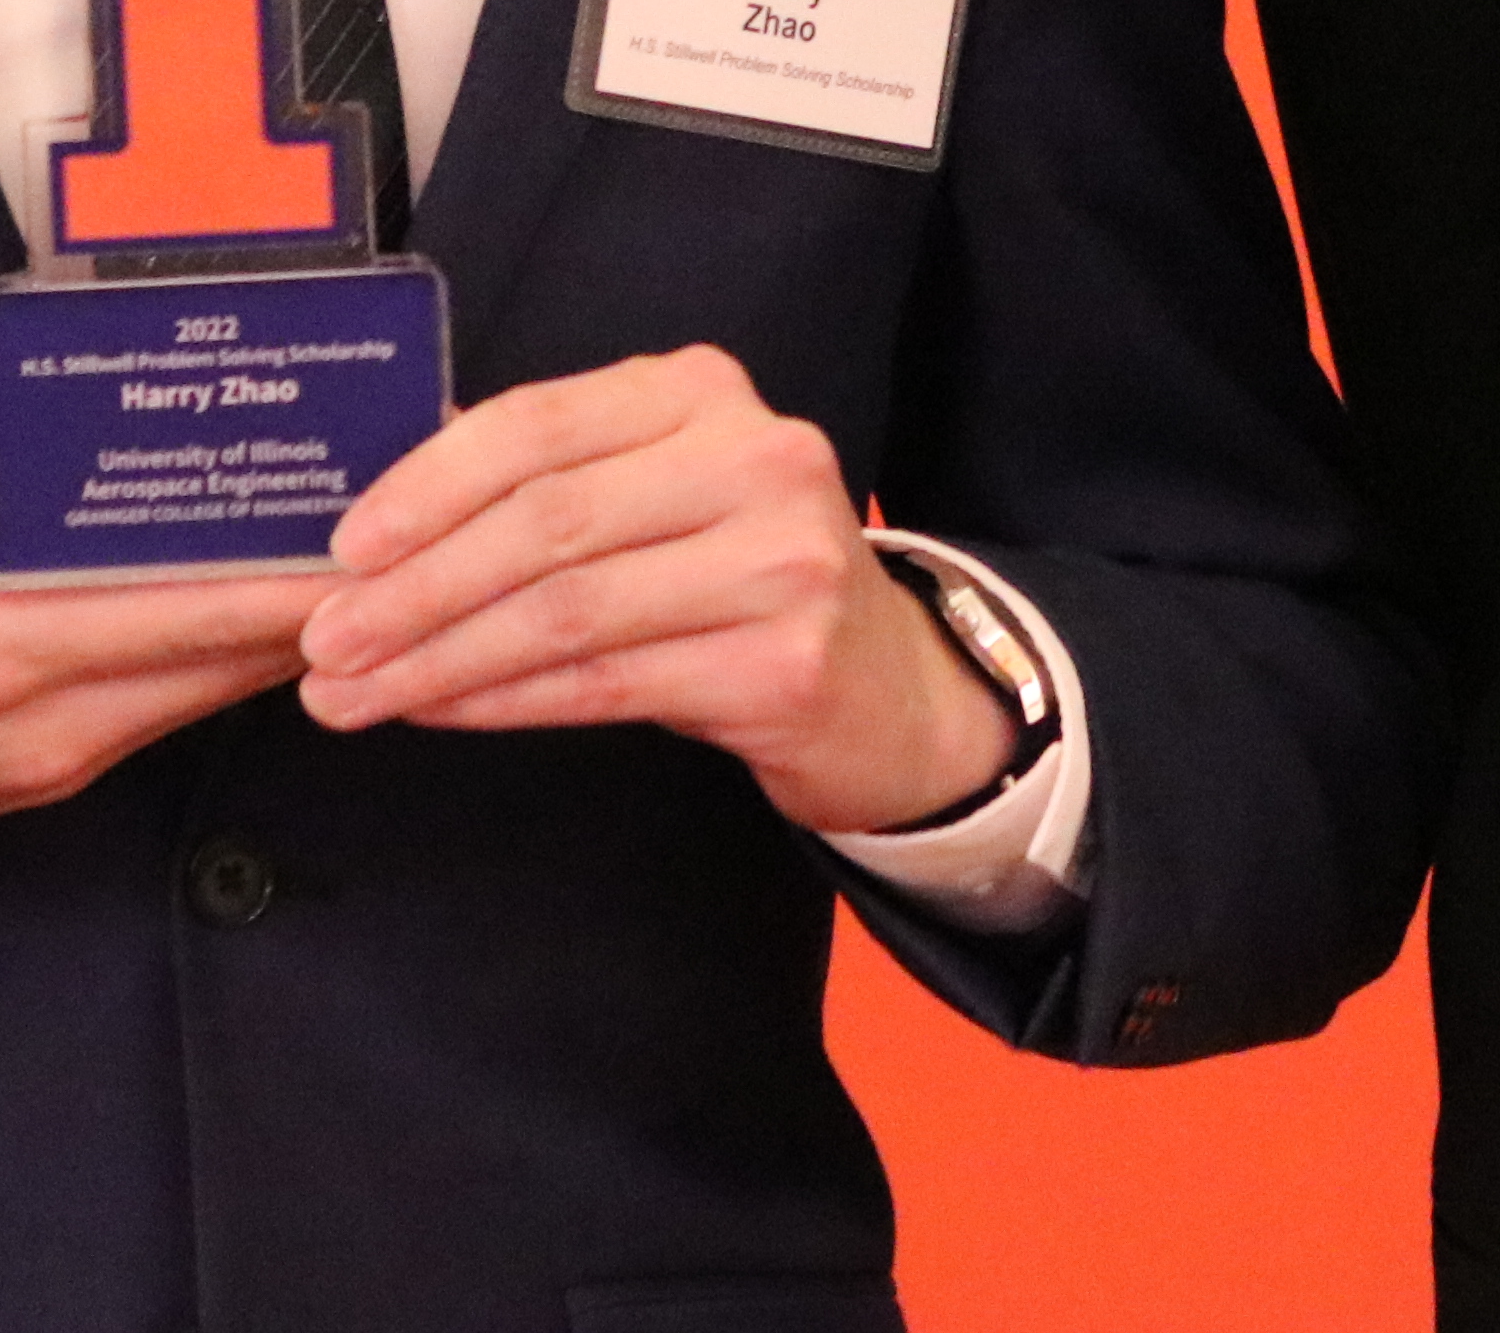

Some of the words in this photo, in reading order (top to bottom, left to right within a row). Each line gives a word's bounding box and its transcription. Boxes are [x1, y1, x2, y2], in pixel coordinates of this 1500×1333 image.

[742, 3, 817, 42] Zhao
[719, 49, 778, 75] Problem
[782, 61, 832, 89] Solving
[836, 71, 915, 100] Scholarship
[174, 314, 241, 343] 2022
[138, 348, 216, 370] Problem
[218, 345, 286, 368] Solving
[288, 339, 398, 363] Scholarship
[121, 381, 215, 414] Harry
[220, 376, 300, 406] Zhao
[98, 445, 218, 471] University
[220, 439, 248, 466] of
[250, 437, 330, 463] Illinois
[81, 477, 201, 504] Aerospace
[207, 468, 347, 498] Engineering
[152, 501, 226, 522] COLLEGE
[227, 499, 250, 519] OF
